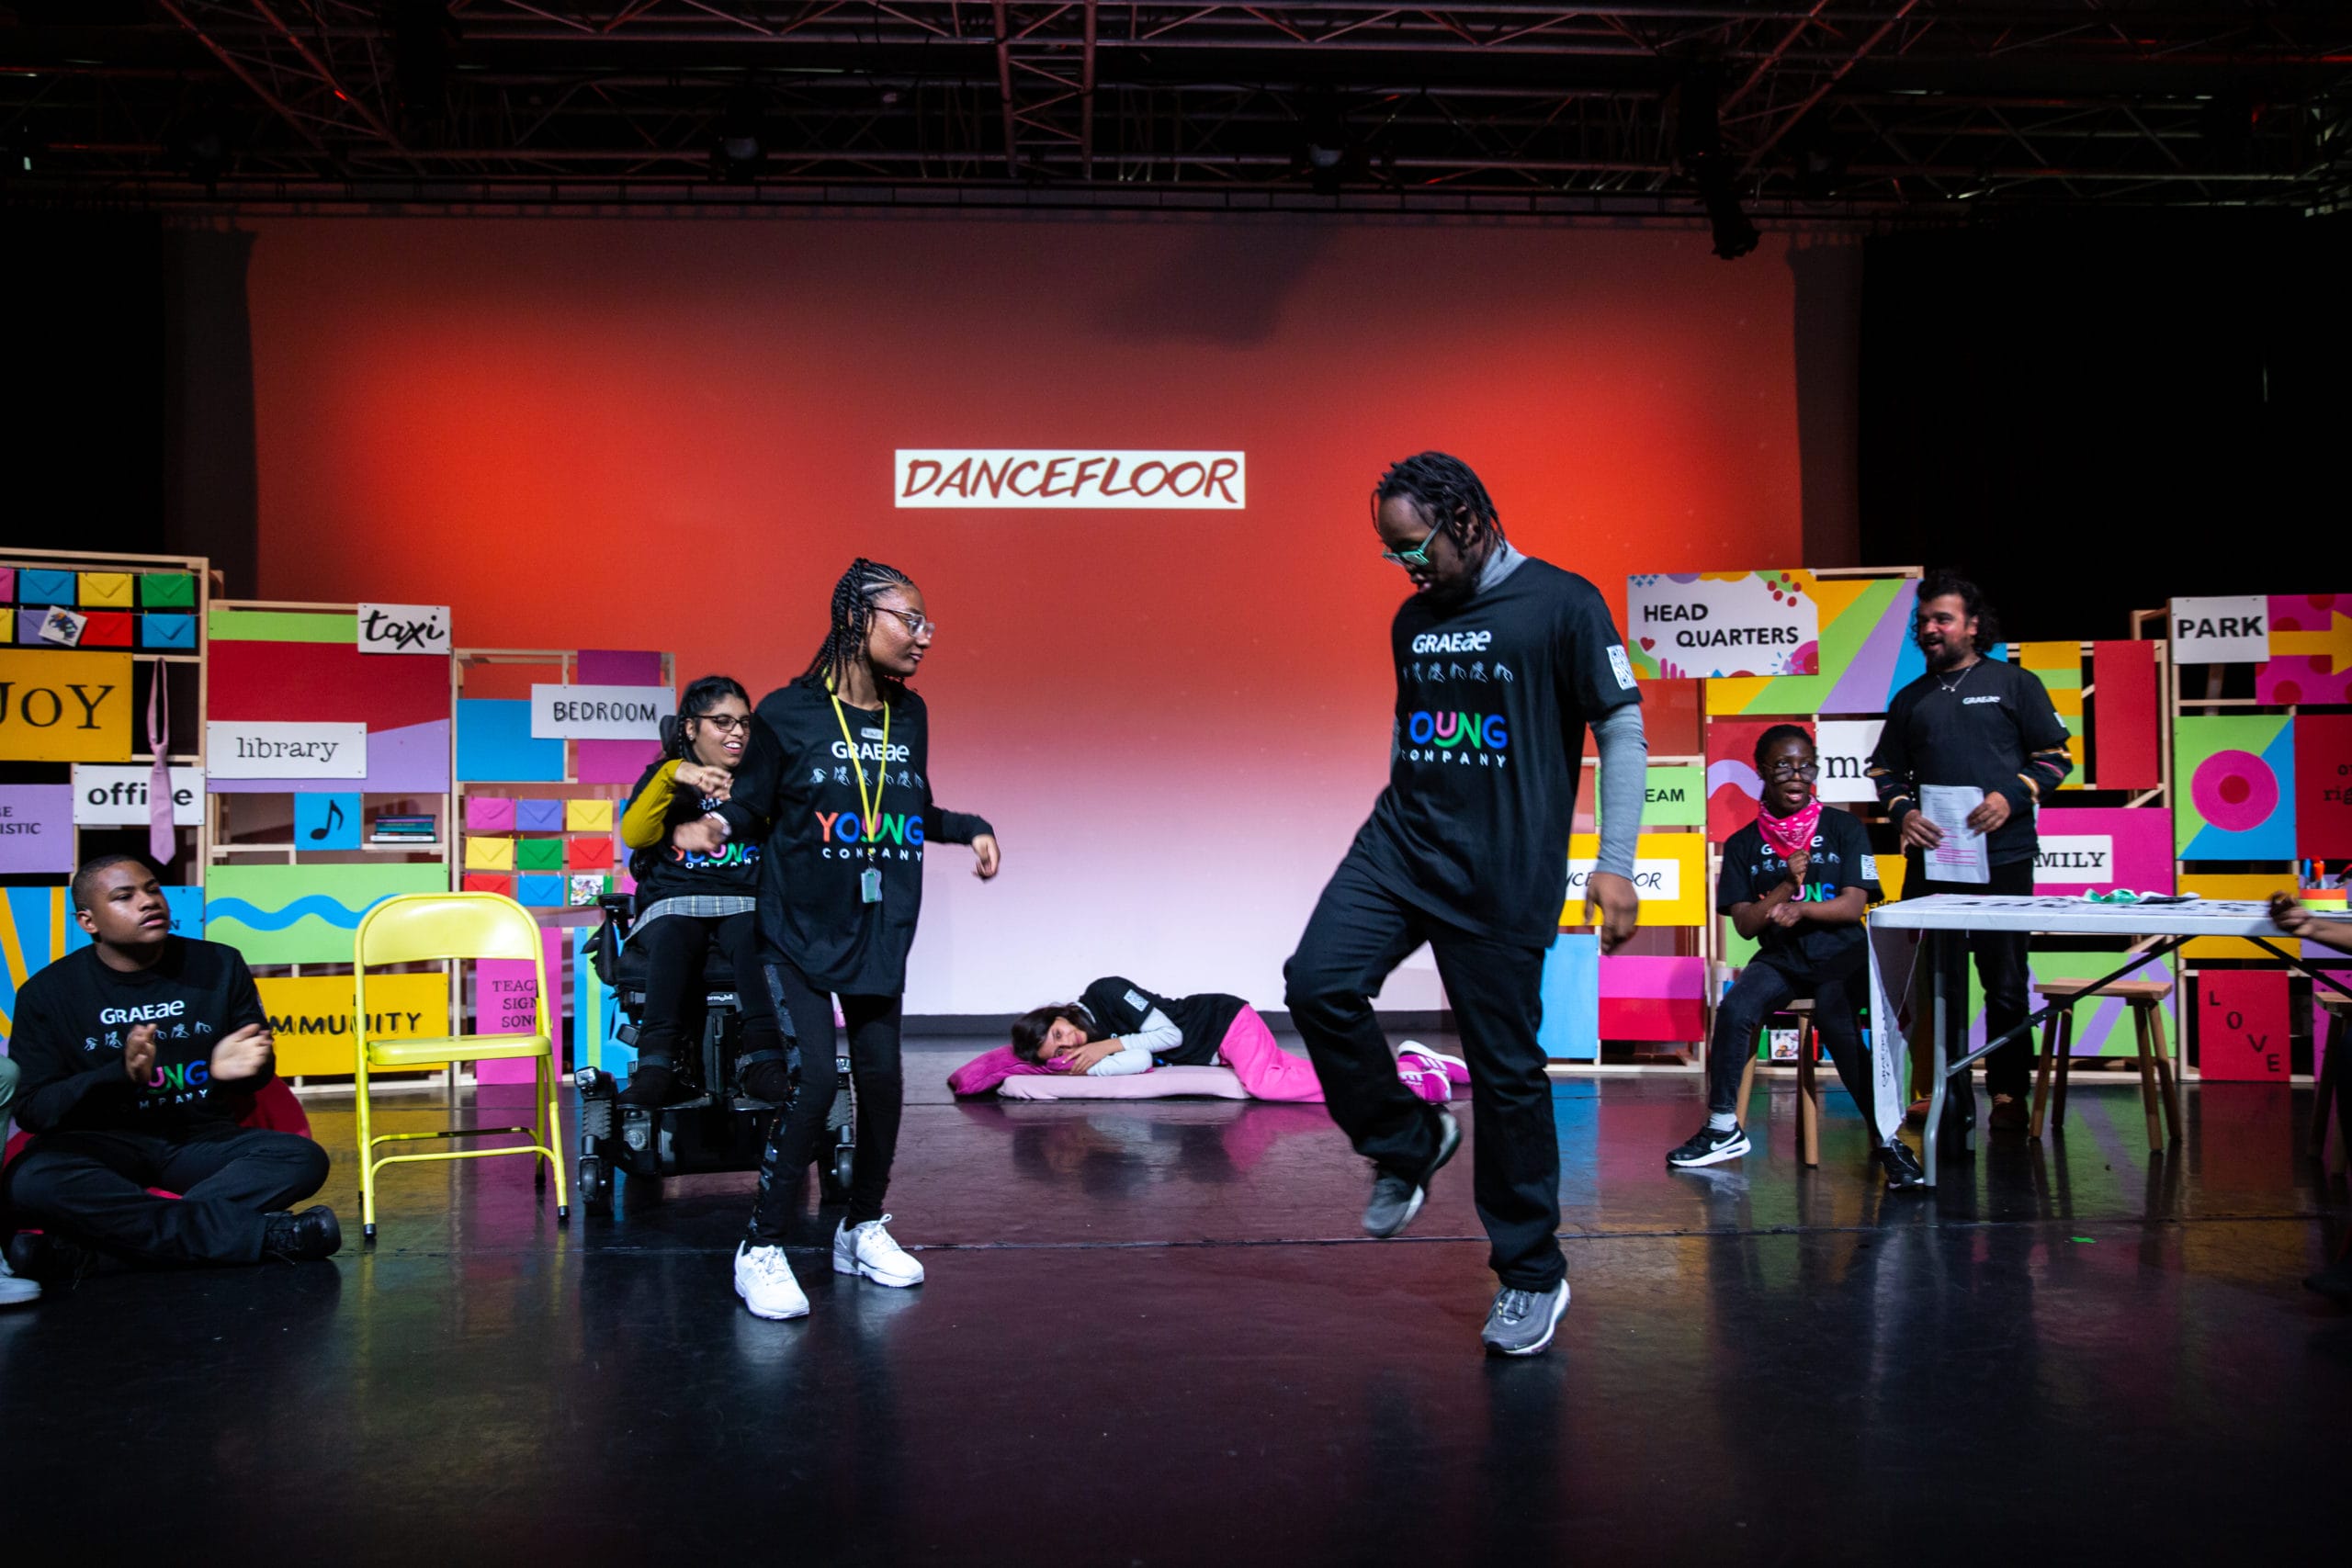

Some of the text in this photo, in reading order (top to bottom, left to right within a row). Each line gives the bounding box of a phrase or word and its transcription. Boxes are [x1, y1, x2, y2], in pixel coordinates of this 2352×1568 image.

[901, 457, 1239, 503] DANCEFLOOR
[1643, 603, 1709, 623] HEAD
[360, 609, 446, 649] taxi
[1675, 626, 1799, 649] QUARTERS
[2177, 615, 2264, 639] PARK
[0, 682, 116, 729] JOY
[553, 701, 658, 723] BEDROOM
[1408, 710, 1509, 750] OUNG
[236, 737, 340, 763] library
[1401, 749, 1507, 769] OMPANY
[87, 782, 194, 807] offie
[1645, 788, 1685, 803] EAM
[0, 822, 41, 835] ISTIC
[814, 811, 924, 846] YOUNG
[684, 854, 761, 869] OMPANY
[2033, 852, 2107, 868] MILY
[492, 979, 537, 993] TEAC
[269, 1011, 422, 1036] MMUITY
[502, 1014, 537, 1029] SON
[146, 1059, 209, 1095] UNG
[139, 1089, 209, 1110] MPANY
